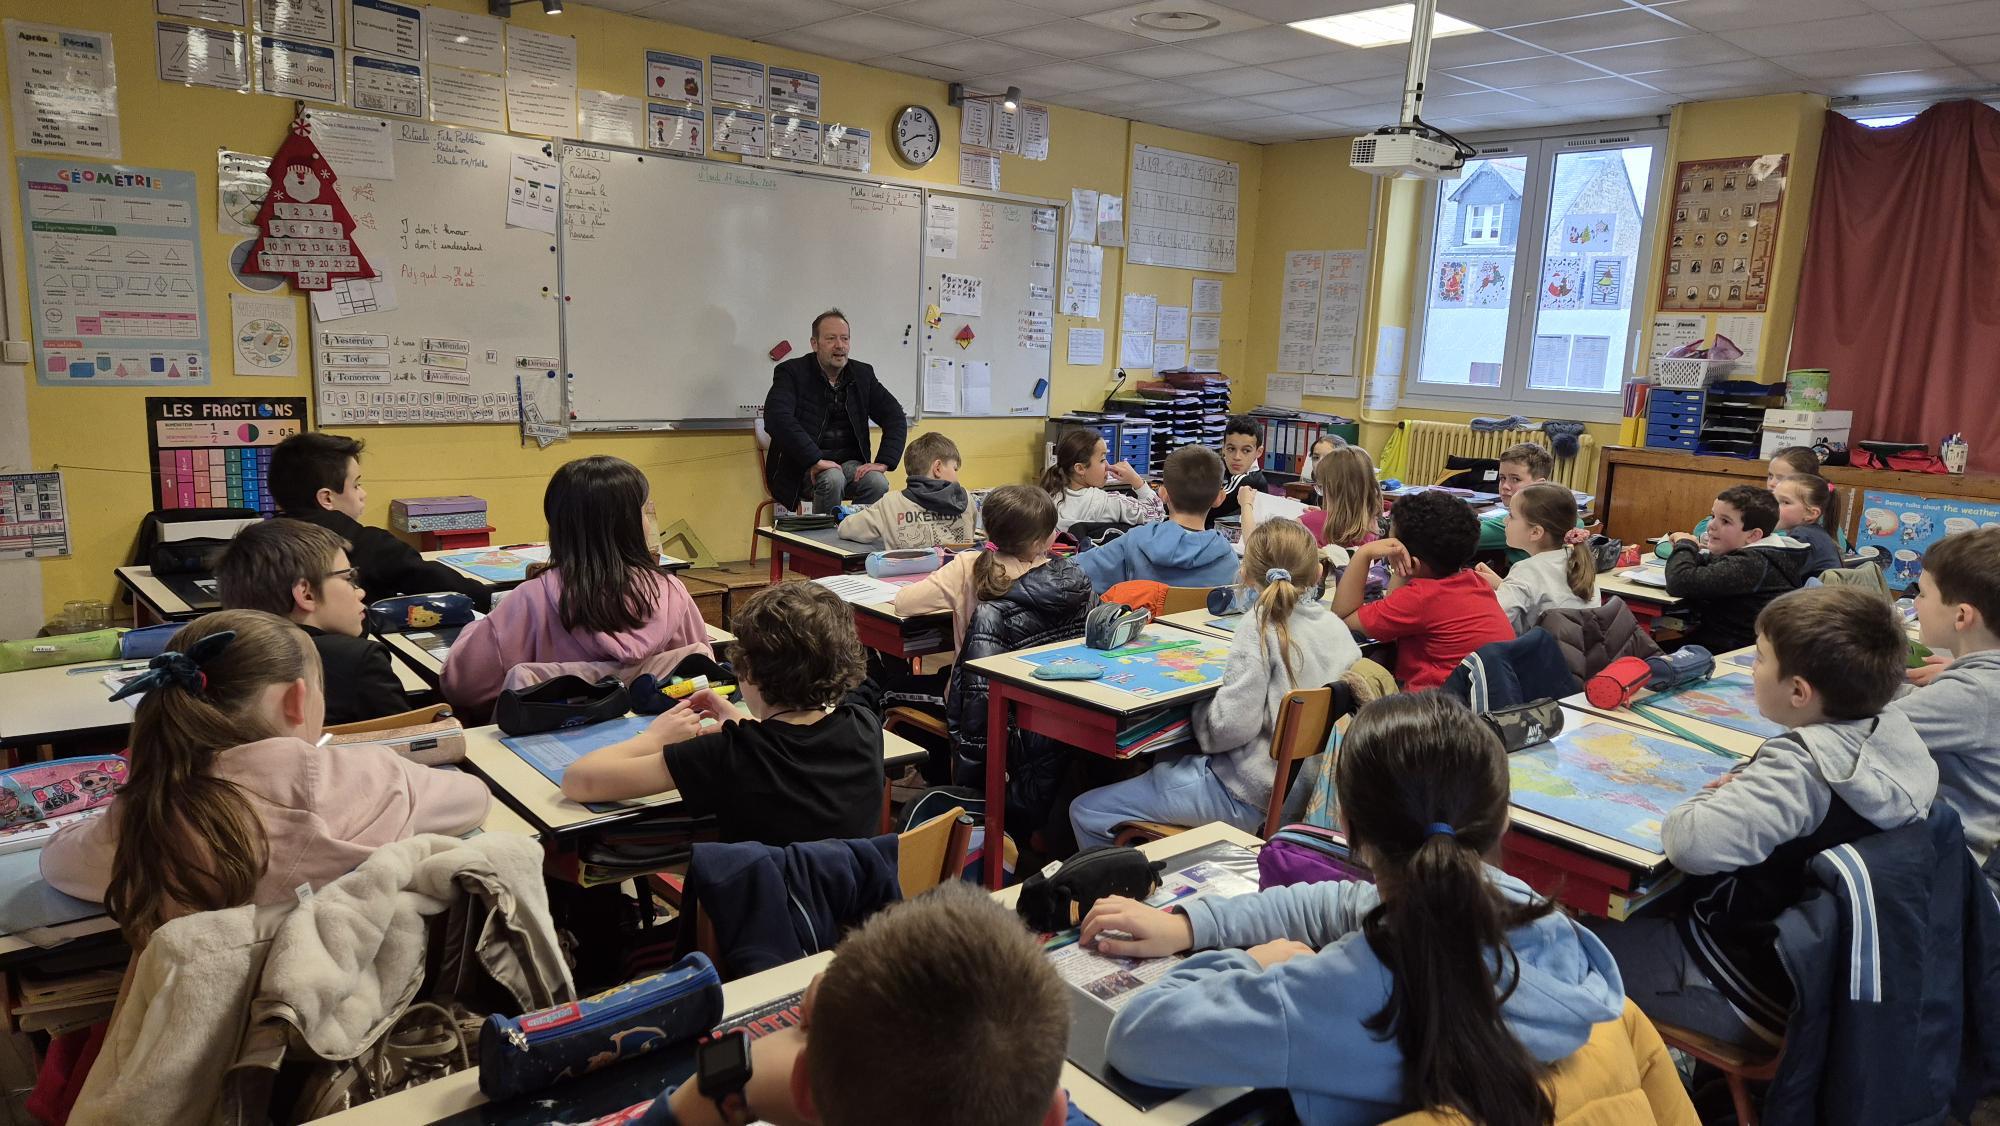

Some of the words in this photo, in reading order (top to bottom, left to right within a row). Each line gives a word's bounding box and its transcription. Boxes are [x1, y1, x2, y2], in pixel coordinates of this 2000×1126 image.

[18, 32, 48, 42] Après
[914, 112, 922, 122] 12
[901, 129, 906, 137] 9
[928, 134, 934, 143] 3
[913, 150, 919, 158] 6
[57, 169, 162, 190] GÉOMÉTRIE
[294, 208, 299, 216] 2
[274, 225, 280, 233] 5
[304, 226, 310, 234] 7
[318, 226, 324, 234] 8
[332, 227, 338, 235] 9
[414, 224, 438, 235] don't
[442, 224, 468, 236] know
[269, 242, 278, 251] 10
[284, 243, 291, 251] 11
[298, 243, 307, 251] 12
[325, 244, 334, 252] 14
[338, 244, 347, 252] 15
[414, 240, 437, 250] don't
[441, 242, 484, 252] understand
[262, 259, 271, 267] 16
[277, 259, 285, 267] 17
[292, 259, 300, 267] 18
[306, 260, 315, 268] 19
[319, 260, 329, 268] 20
[334, 260, 342, 268] 21
[346, 260, 356, 268] 22
[300, 276, 311, 284] 23
[333, 336, 374, 347] Yesterday
[437, 341, 467, 352] Monday
[343, 354, 369, 366] Today
[526, 359, 559, 369] December
[337, 372, 381, 381] Tomorrow
[431, 372, 469, 382] Wednesday
[327, 393, 331, 401] 1
[360, 392, 365, 401] 3
[410, 393, 415, 402] 7
[449, 394, 457, 402] 10
[469, 396, 477, 404] 12
[484, 395, 493, 403] 13
[162, 404, 193, 418] LES
[203, 403, 293, 418] FRACTIONS
[384, 410, 393, 418] 21
[396, 410, 407, 418] 22
[424, 409, 434, 417] 24
[435, 410, 444, 418] 25
[445, 408, 455, 417] 26
[210, 422, 216, 432] 1
[211, 435, 218, 443] 2
[166, 479, 172, 488] 1
[1905, 501, 1921, 509] talks
[1922, 503, 1941, 511] about
[1943, 504, 1959, 513] the
[1961, 507, 2000, 517] weather
